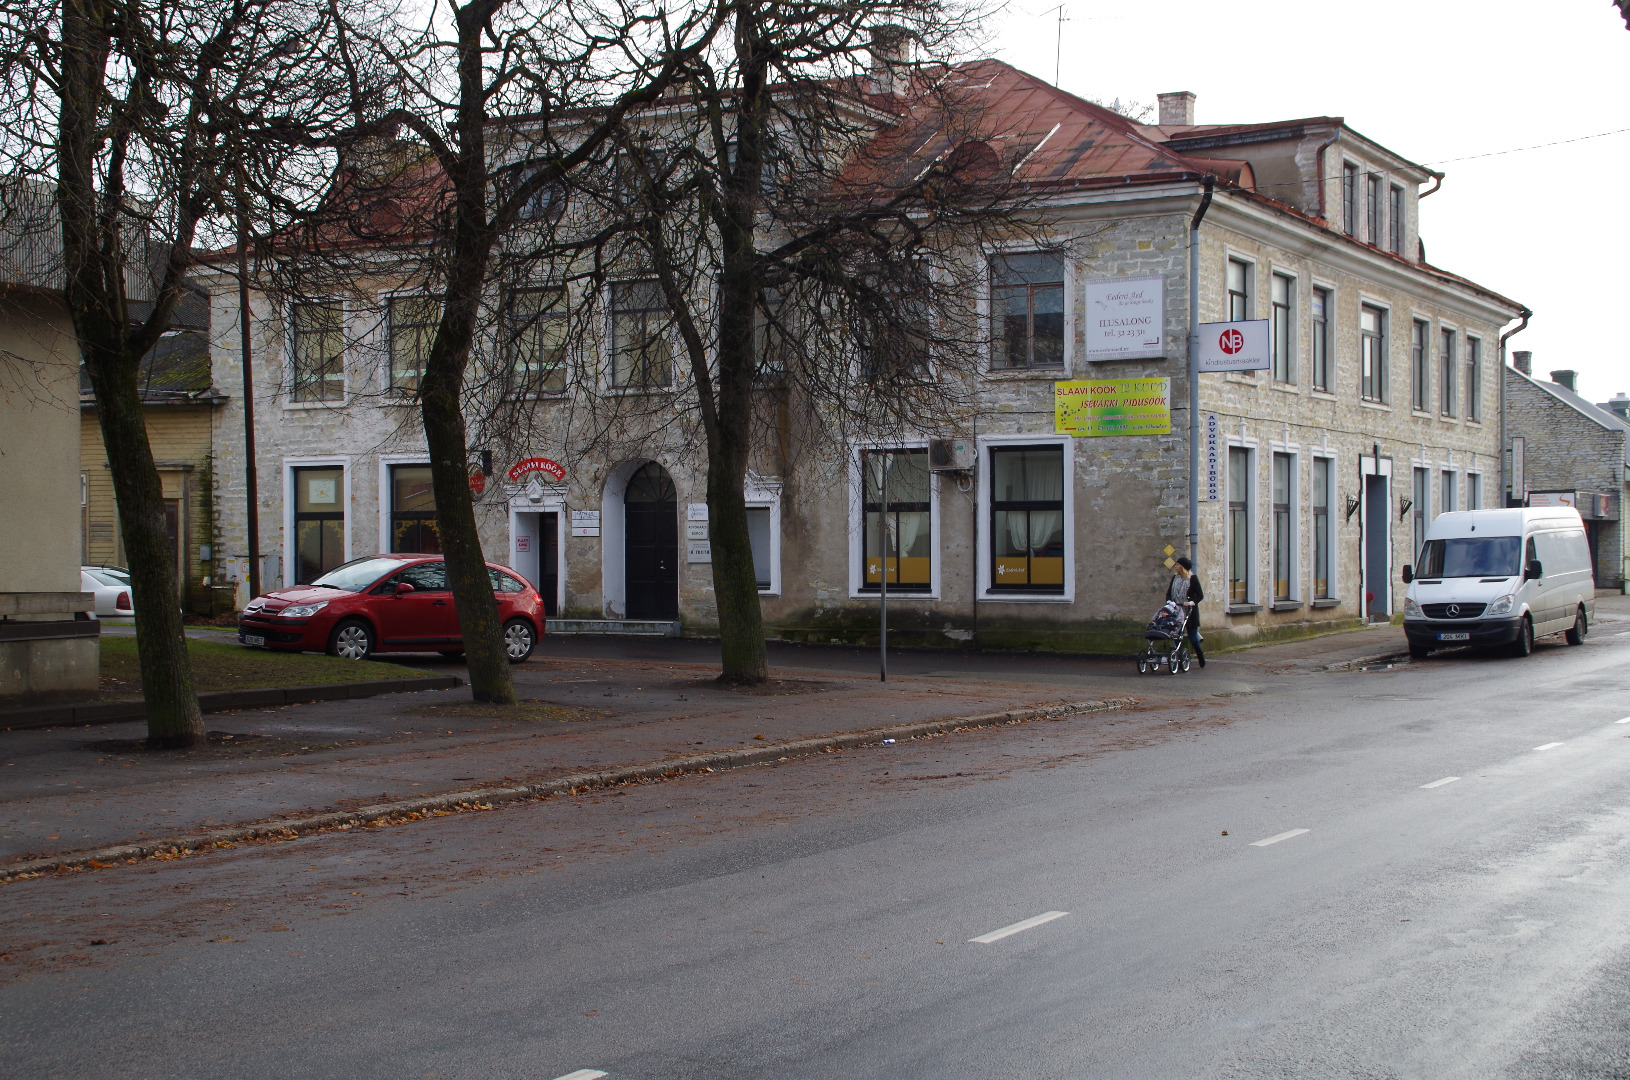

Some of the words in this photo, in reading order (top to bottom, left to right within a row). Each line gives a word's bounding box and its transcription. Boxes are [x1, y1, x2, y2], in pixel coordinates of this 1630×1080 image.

[1099, 317, 1152, 327] ILUSALONG
[1117, 330, 1125, 338] 32
[1220, 330, 1243, 353] NB
[1205, 358, 1261, 366] kindlustusmaakler
[1056, 386, 1088, 396] SLAAVI
[1208, 415, 1216, 500] ADVOKAADIBÜROO
